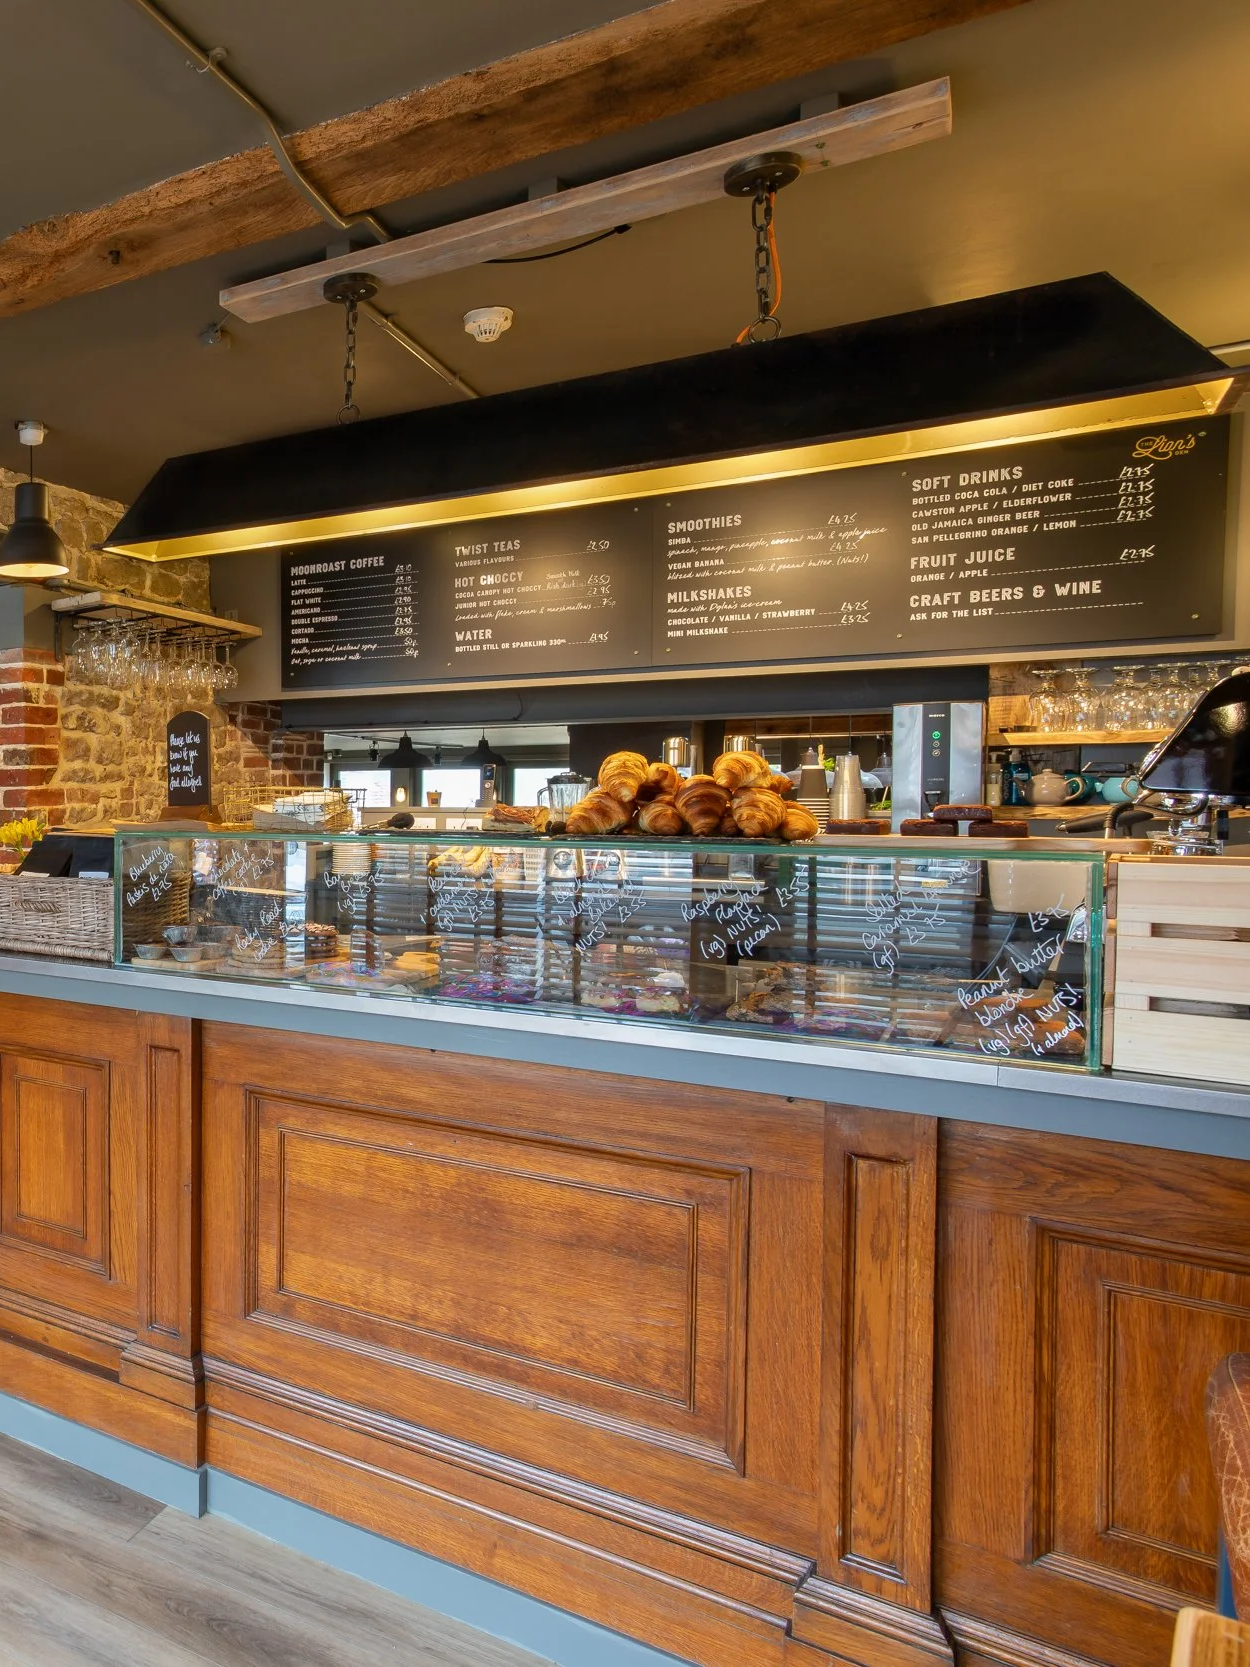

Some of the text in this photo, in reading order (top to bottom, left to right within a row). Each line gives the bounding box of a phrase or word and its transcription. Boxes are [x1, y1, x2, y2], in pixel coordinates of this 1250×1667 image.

[1132, 435, 1196, 460] Lion's
[911, 466, 1023, 492] SOFT DRINKS
[912, 494, 951, 505] BOTTLED
[954, 490, 980, 500] COCA
[983, 486, 1008, 497] COLA
[1022, 482, 1044, 492] DIET
[1047, 478, 1075, 489] COKE
[911, 506, 956, 519] CAWSTON
[959, 502, 990, 513] APPLE
[1002, 492, 1073, 508] ELDERFLOWER
[667, 514, 743, 534] SMOOTHIES
[911, 523, 929, 531] OLD
[931, 517, 975, 530] JAMAICA
[977, 514, 1012, 525] GINGER
[1015, 510, 1041, 520] BEER
[770, 534, 805, 545] coconut
[911, 535, 930, 545] SAN
[932, 530, 988, 543] PELLEGRINO
[991, 525, 1030, 536] ORANGE
[1043, 519, 1077, 531] LEMON
[454, 539, 521, 557] TWIST TEAS
[668, 537, 692, 546] SIMBA
[290, 556, 385, 576] MOONROAST COFFEE
[454, 555, 515, 568] VARIOUS FLAVOURS
[668, 558, 725, 571] VEGAN BANANA
[910, 547, 1016, 570] FRUIT JUICE
[454, 571, 524, 588] HOT CHOCCY
[695, 568, 713, 578] with
[713, 565, 747, 576] coconut
[910, 572, 946, 583] ORANGE
[958, 569, 989, 579] APPLE
[291, 587, 324, 596] CAPPUCCINO
[455, 591, 475, 599] COCOA
[476, 588, 501, 597] CANOPY
[517, 584, 542, 593] CHOCCY
[667, 585, 752, 604] MILKSHAKES
[909, 579, 1103, 608] CRAFT BEERS & WINE
[291, 598, 304, 606] FLAT
[455, 601, 477, 609] JUNIOR
[492, 598, 518, 606] CHOCCY
[666, 605, 691, 614] made
[690, 603, 708, 612] with
[291, 607, 321, 616] AMERICANO
[291, 615, 338, 625] DOUBLE ESPRESSO
[667, 616, 709, 626] CHOCOLATE
[718, 613, 752, 622] VANILLA
[762, 608, 816, 619] STRAWBERRY
[909, 607, 994, 621] ASK FOR THE LIST
[291, 627, 315, 635] CORTADO
[455, 629, 493, 642] WATER
[667, 630, 685, 638] MINI
[686, 626, 729, 637] MILKSHAKE
[291, 637, 310, 645] MOCHA
[455, 644, 481, 652] BOTTLED
[482, 643, 499, 651] STILL
[512, 640, 547, 648] SPARKLING
[129, 846, 166, 881] Blueberry
[149, 872, 160, 885] de
[680, 877, 740, 922] Raspberry
[726, 904, 766, 940] NUTS!
[575, 921, 611, 953] NUTS!
[957, 933, 1065, 1010] Peanut butter
[974, 987, 1034, 1027] blondie
[1035, 982, 1082, 1023] NUTS!
